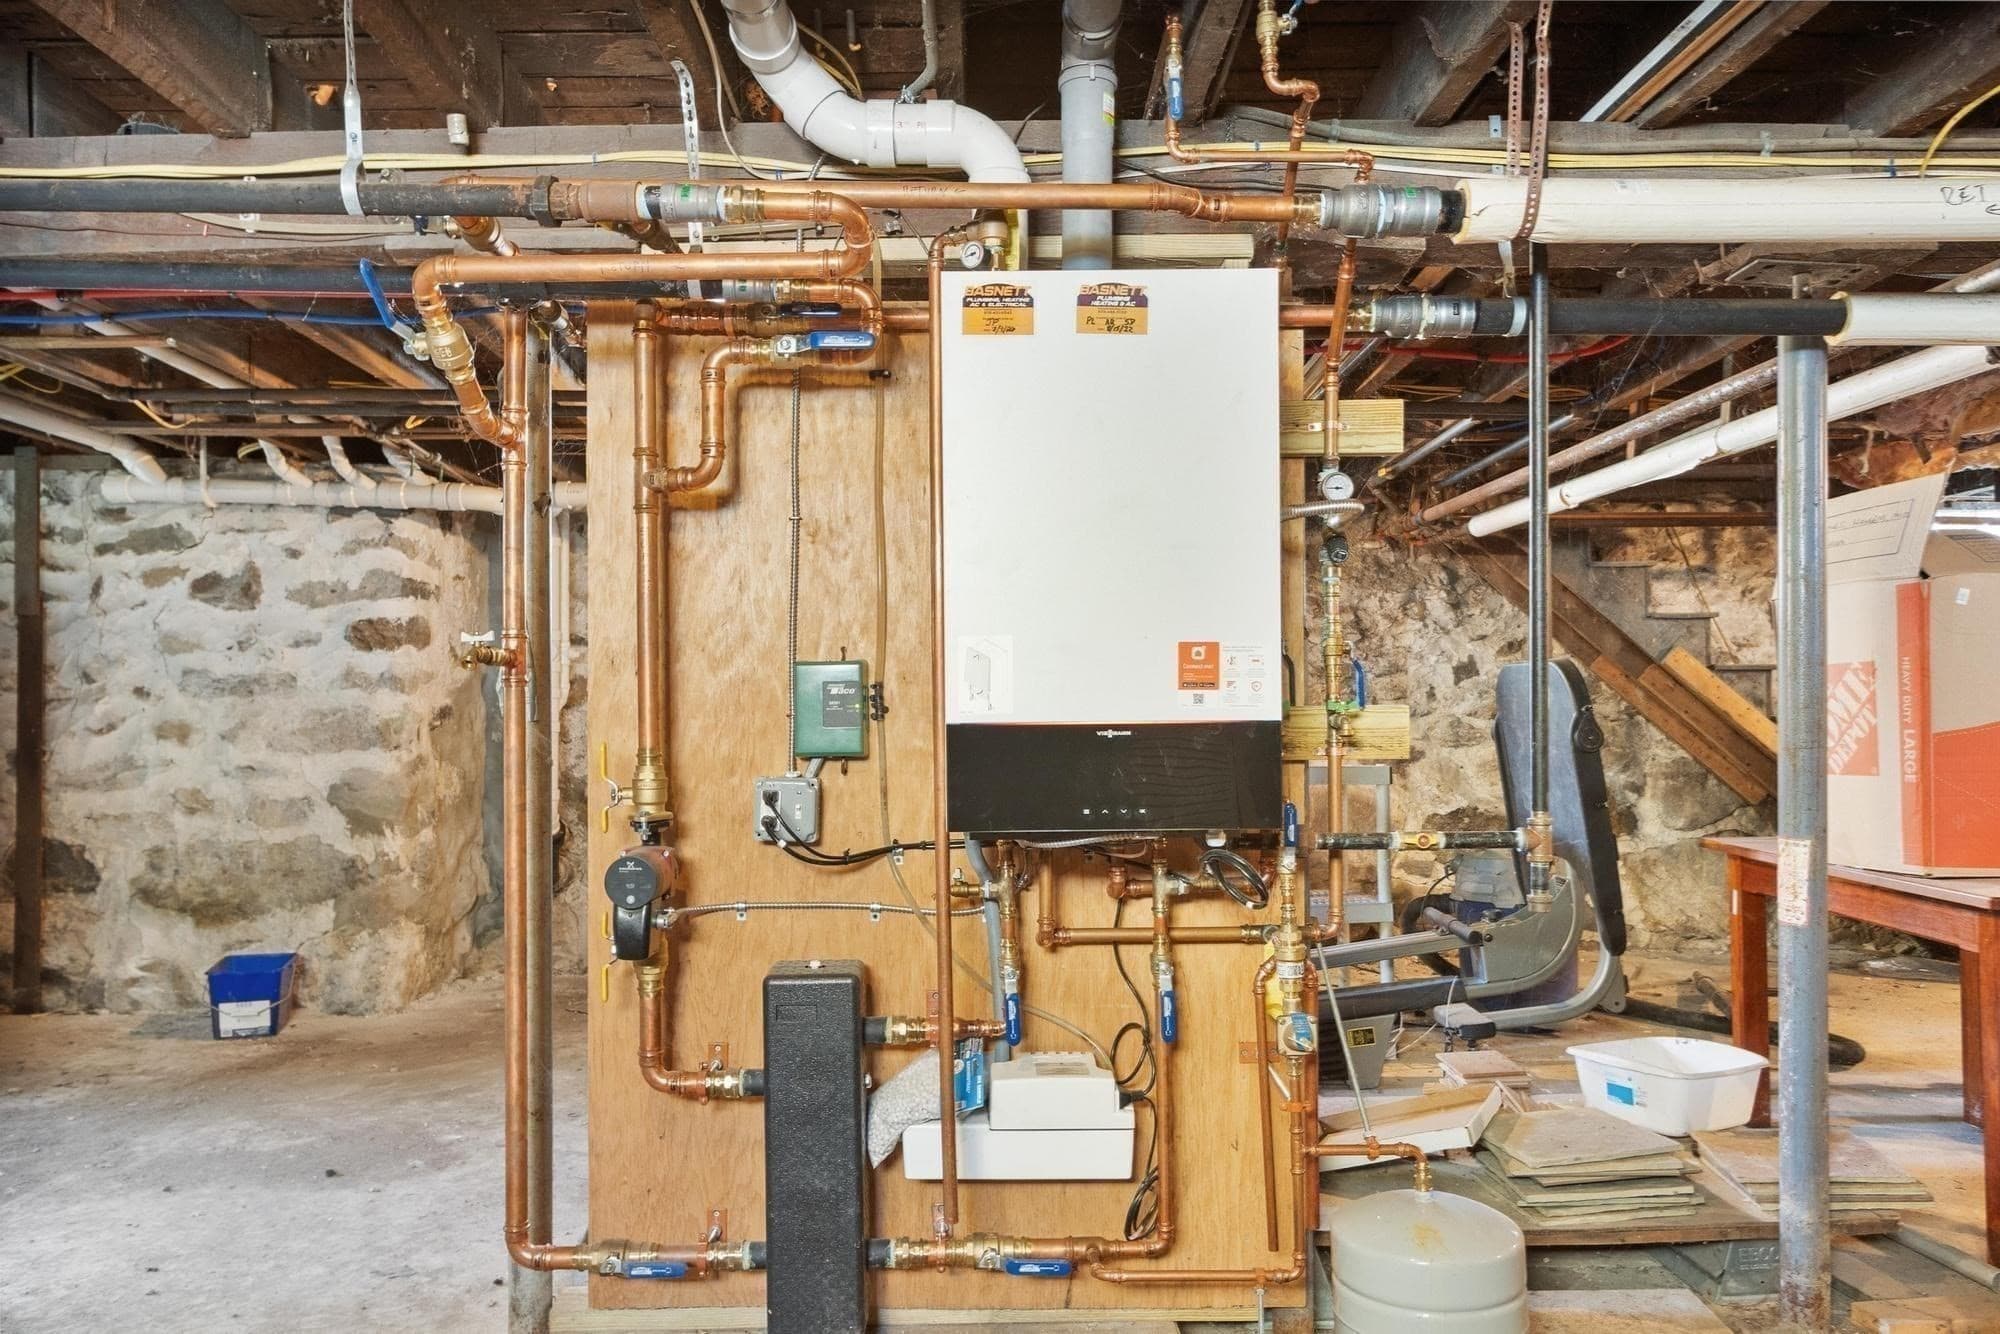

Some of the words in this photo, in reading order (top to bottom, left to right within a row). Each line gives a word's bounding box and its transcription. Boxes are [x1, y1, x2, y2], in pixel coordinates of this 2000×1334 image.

[965, 285, 1032, 297] BASNETT
[1080, 284, 1147, 296] BASNETT
[1900, 655, 1912, 692] HEAVY
[1902, 695, 1912, 724] DUTY
[1903, 728, 1918, 784] LARGE
